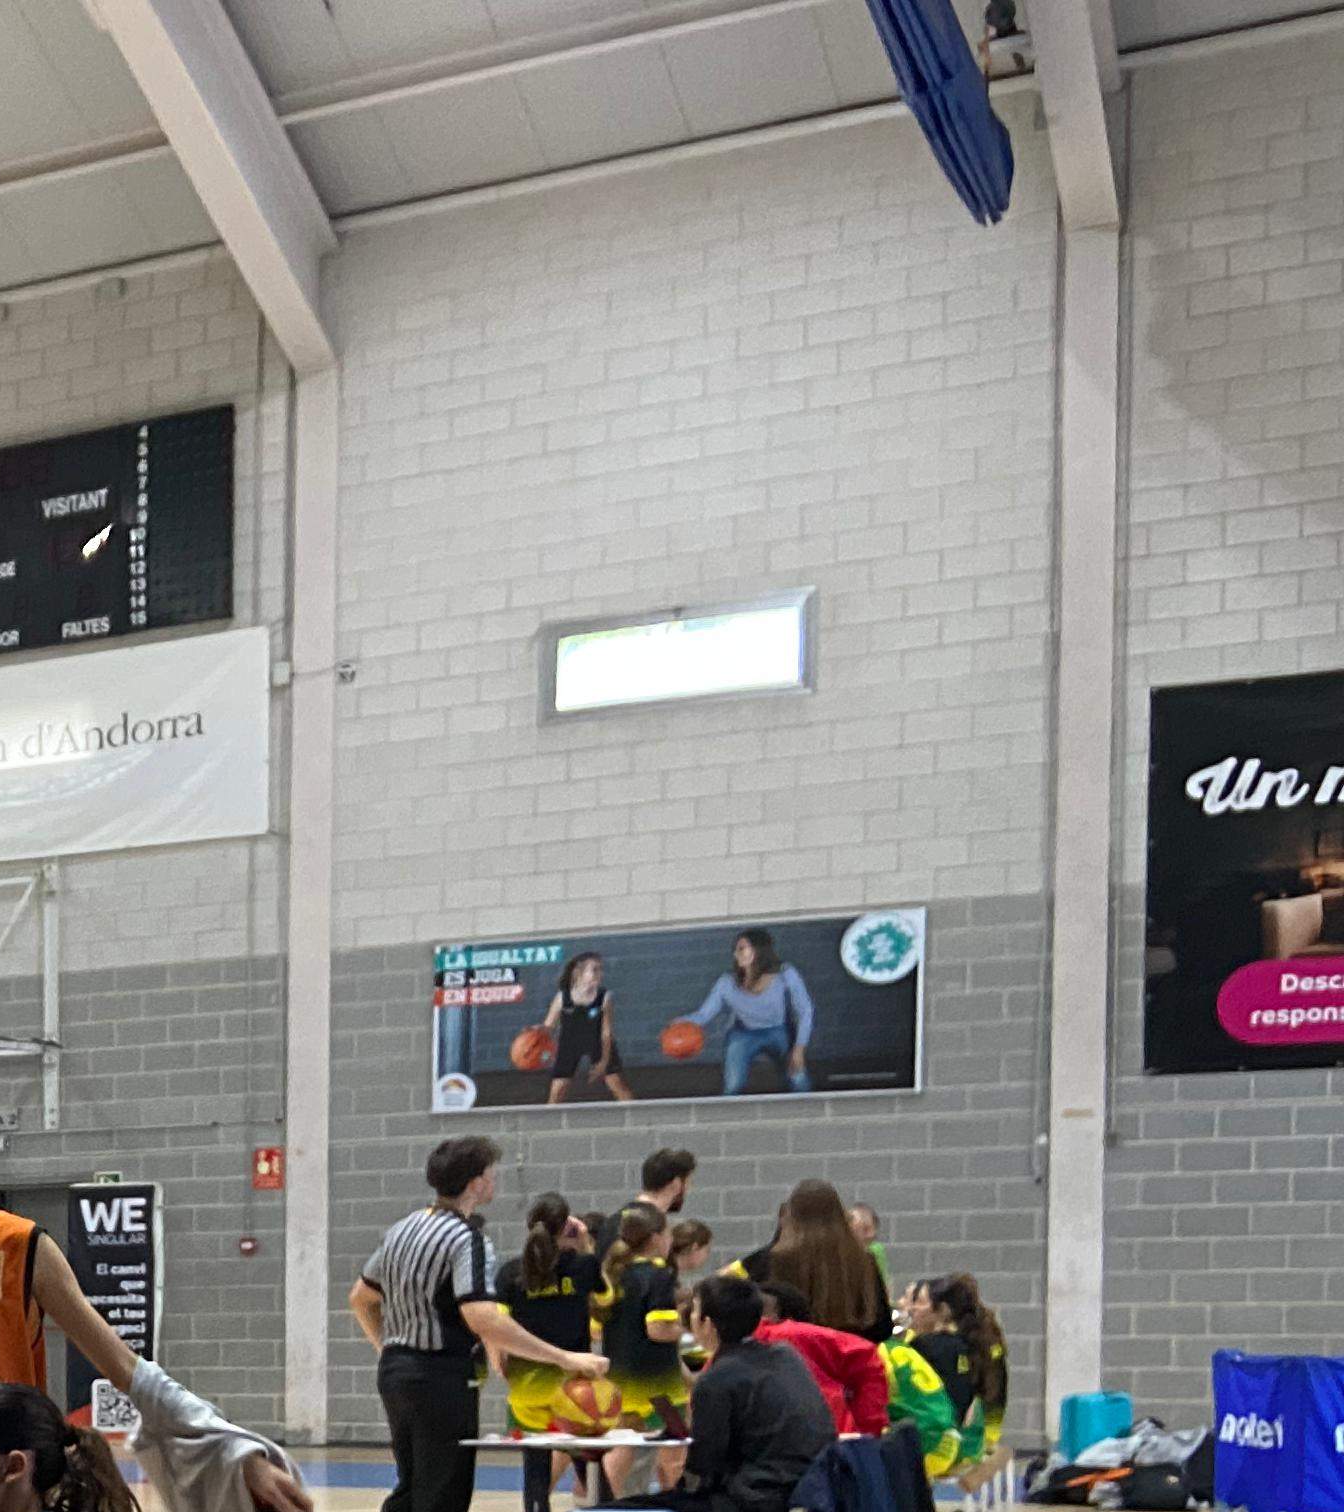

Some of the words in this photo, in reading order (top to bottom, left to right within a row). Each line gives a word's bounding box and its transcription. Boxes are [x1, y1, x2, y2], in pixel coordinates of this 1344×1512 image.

[41, 488, 109, 520] VISITANT
[129, 544, 146, 558] 11
[62, 615, 110, 639] FALTES
[22, 711, 205, 760] d'Andorra
[1185, 755, 1311, 815] Un
[1280, 972, 1344, 993] Desc
[80, 1197, 147, 1232] WE
